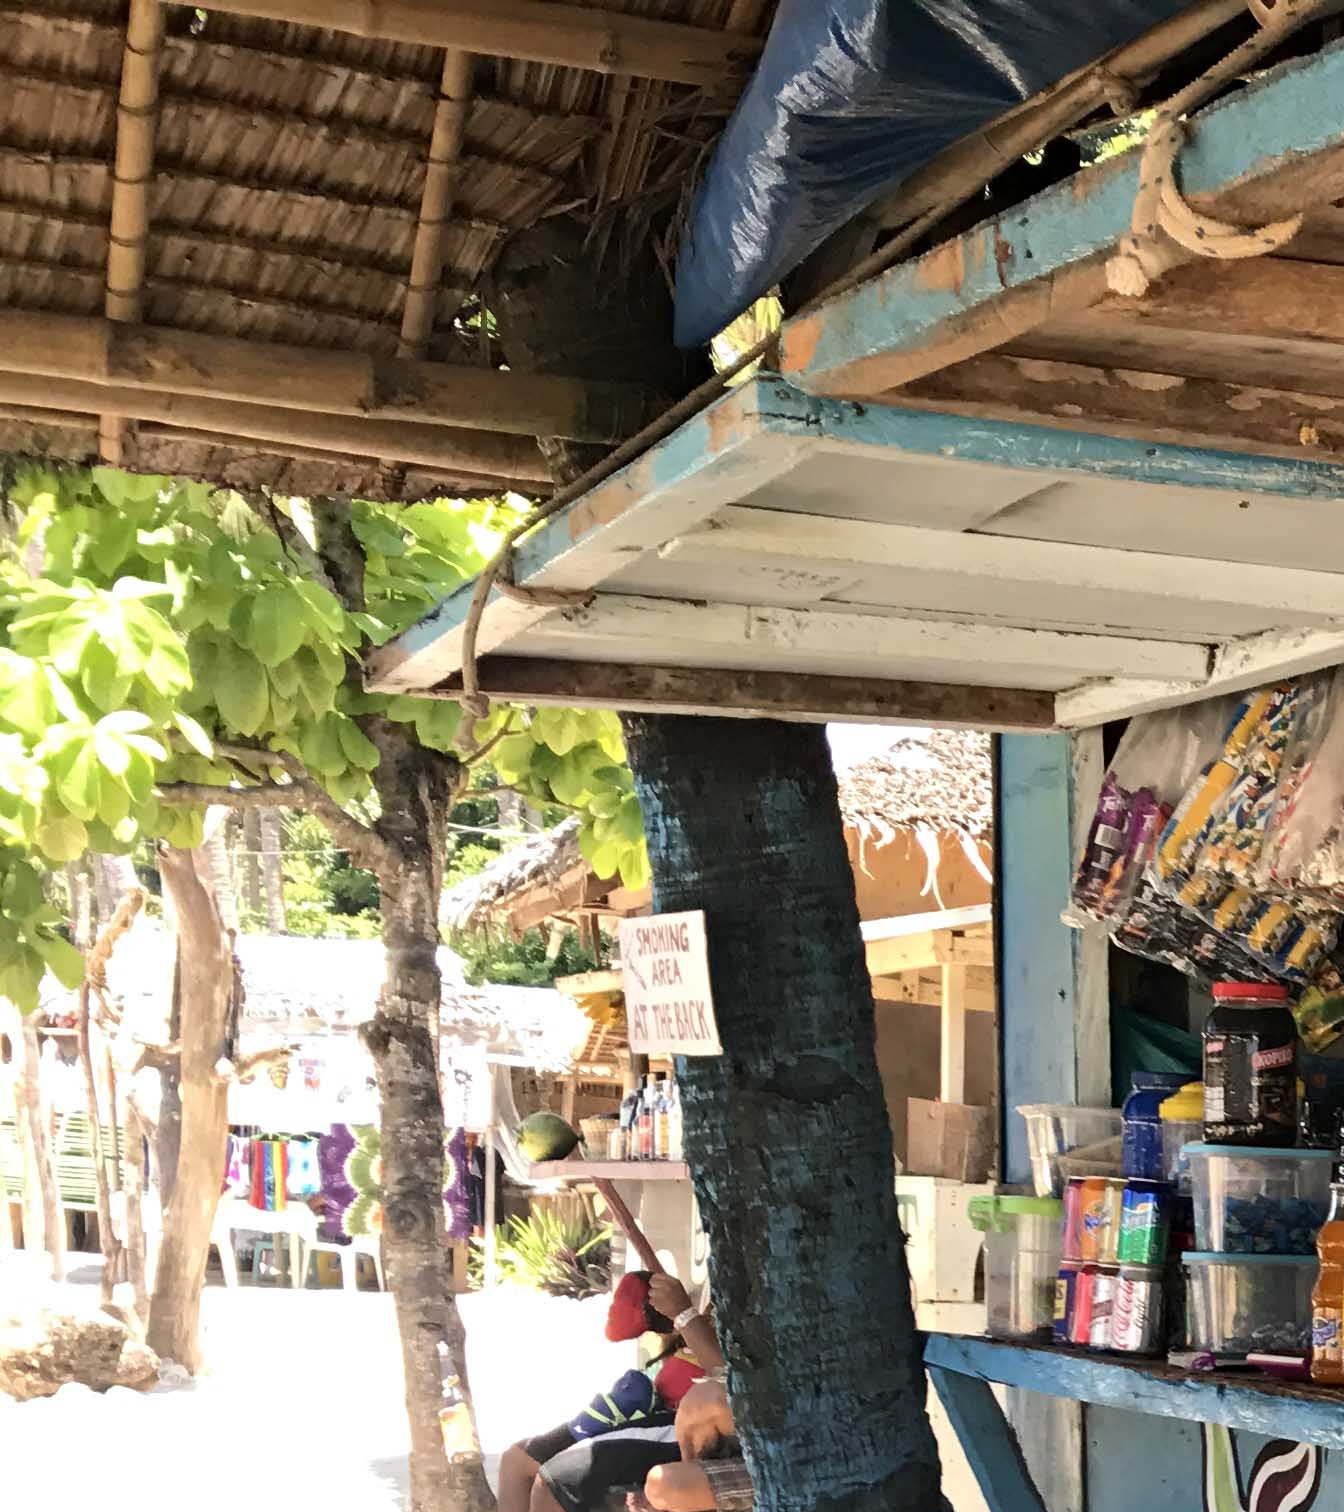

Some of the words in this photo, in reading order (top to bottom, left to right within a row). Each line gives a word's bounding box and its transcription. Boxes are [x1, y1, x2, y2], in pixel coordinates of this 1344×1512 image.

[636, 922, 689, 956] SMOKING
[652, 958, 684, 986] AREA
[634, 1004, 650, 1041] AT
[652, 1003, 675, 1040] THE
[674, 999, 711, 1041] BACK
